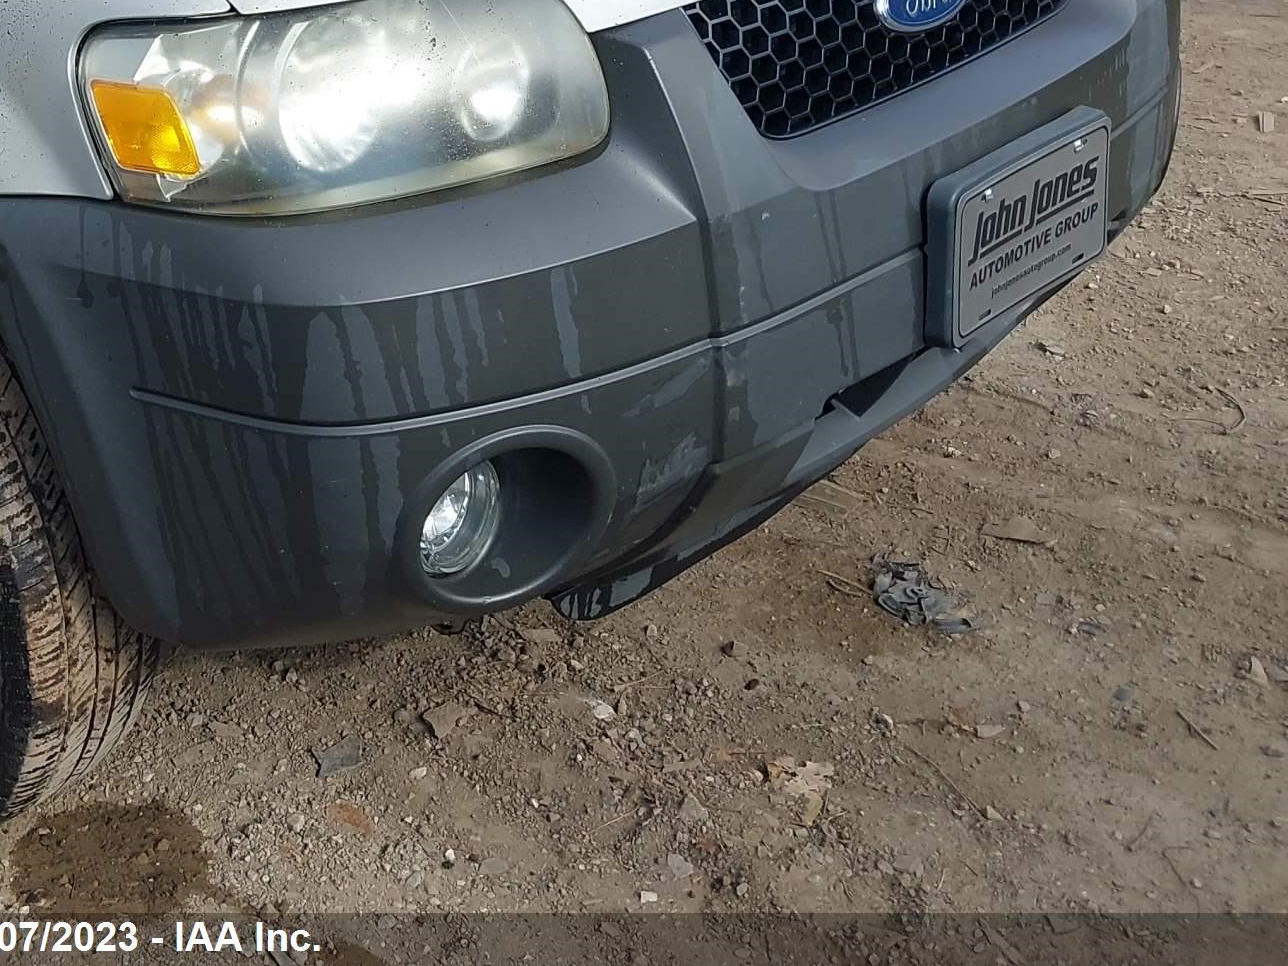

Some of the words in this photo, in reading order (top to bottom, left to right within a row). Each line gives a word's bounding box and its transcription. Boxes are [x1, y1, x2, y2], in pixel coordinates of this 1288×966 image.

[967, 195, 1028, 267] John
[1023, 155, 1100, 233] Jones
[969, 230, 1052, 291] AUTOMOTIVE
[1054, 202, 1099, 239] GROUP
